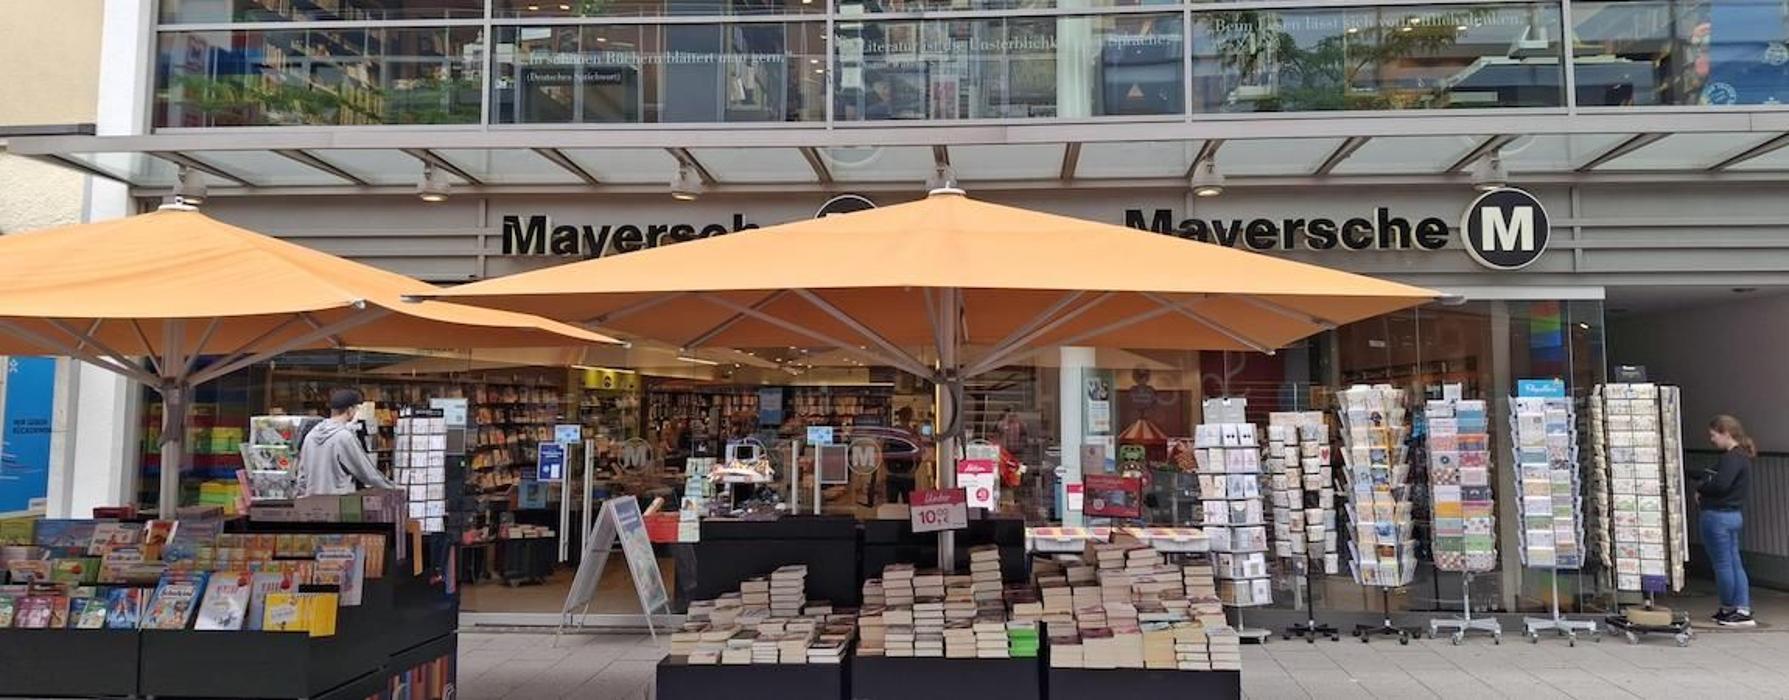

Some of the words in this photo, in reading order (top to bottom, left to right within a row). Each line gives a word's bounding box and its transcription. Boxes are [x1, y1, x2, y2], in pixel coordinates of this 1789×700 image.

[1215, 18, 1253, 32] Beim
[605, 50, 662, 65] Büchern
[666, 50, 714, 65] blättert
[1480, 205, 1535, 252] M
